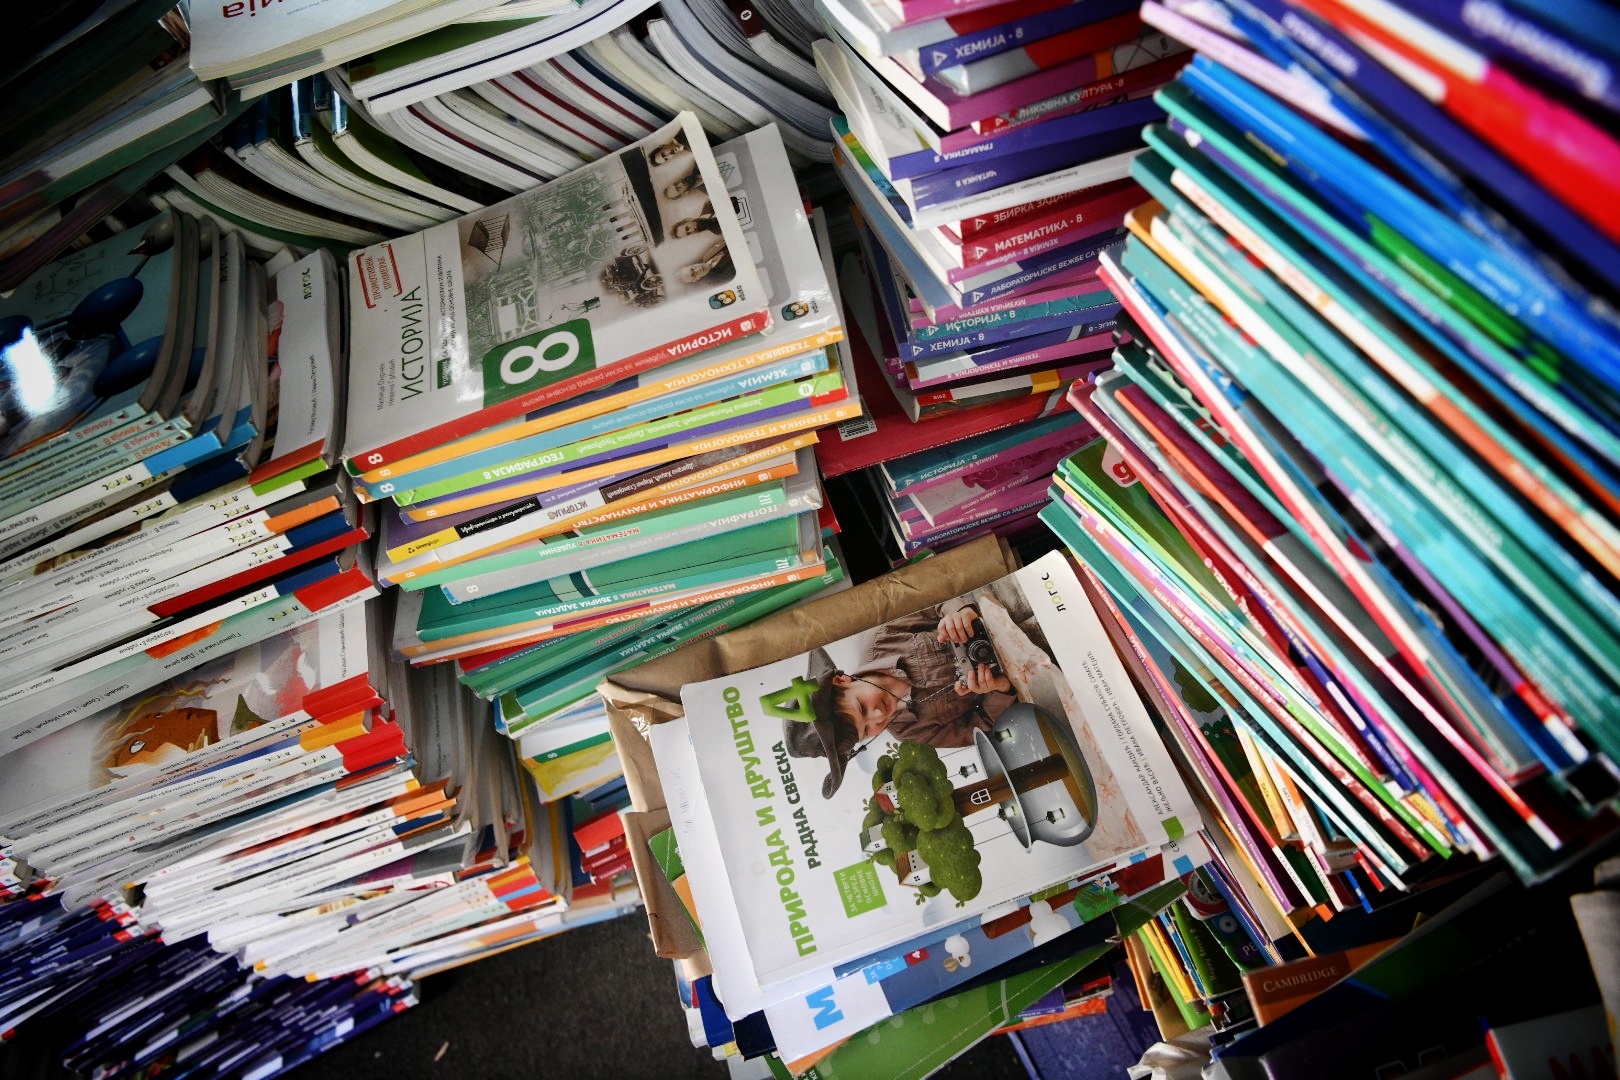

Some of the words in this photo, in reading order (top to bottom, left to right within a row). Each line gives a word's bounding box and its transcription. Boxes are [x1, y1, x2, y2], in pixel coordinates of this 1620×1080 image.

[954, 32, 1006, 57] ХЕМИЈА
[1014, 26, 1024, 38] 8
[1018, 94, 1068, 118] ЛИКОВНА
[1068, 82, 1113, 102] КУЛТУРА
[942, 141, 993, 160] ГРАМАТИКА
[961, 169, 997, 184] ЧИТАНКА
[992, 202, 1033, 223] ЗБИРКА
[994, 220, 1068, 252] МАТЕМАТИКА
[1074, 213, 1083, 223] 8
[1028, 237, 1059, 253] ХЕМИЈА
[366, 256, 380, 300] ПРОМОТИВНИ
[378, 254, 391, 289] ПРИМЕРАК
[989, 264, 1057, 294] ЛАБОРАТОРИЈСКЕ
[1057, 254, 1084, 269] ВЕЖБЕ
[1084, 250, 1095, 259] СА
[302, 267, 310, 299] логос
[990, 298, 1025, 311] МУЗИЧКА
[945, 313, 1001, 331] ИСТОРИЈА
[1008, 310, 1015, 318] 8
[401, 283, 421, 403] ИСТОРИЈА
[666, 326, 732, 357] ИСТОРИЈА
[756, 340, 809, 361] ТЕХНИКА
[929, 336, 970, 351] ХЕМИЈА
[500, 331, 580, 385] 8
[745, 356, 754, 365] И
[1008, 352, 1038, 363] ТЕХНИКА
[663, 360, 743, 389] ТЕХНОЛОГИЈА
[737, 367, 787, 388] ХЕМИЈА
[953, 361, 1001, 377] ТЕХНОЛОГИЈА
[83, 417, 114, 435] Хемија
[111, 423, 142, 442] Хемија
[767, 425, 776, 433] И
[778, 412, 829, 431] ТЕХНИКА
[130, 428, 162, 447] Хемија
[141, 438, 172, 457] Хемија
[691, 427, 766, 452] ТЕХНОЛОГИЈА
[368, 453, 383, 466] 8
[492, 450, 564, 477] ГЕОГРАФИЈА
[728, 459, 739, 468] И
[740, 443, 787, 463] ТЕХНИКА
[379, 467, 390, 476] 8
[482, 470, 492, 479] 8
[658, 463, 726, 491] ТЕХНОЛОГИЈА
[919, 458, 965, 480] ИСТОРИЈА
[378, 481, 394, 494] 8
[659, 478, 746, 506] ИНФОРМАТИКА
[426, 508, 436, 516] 8
[571, 503, 646, 529] РАЧУНАРСТВО
[648, 501, 657, 509] И
[708, 504, 777, 528] ГЕОГРАФИЈА
[584, 527, 639, 545] МАТЕМАТИКА
[538, 541, 576, 556] УЏБЕНИК
[466, 584, 478, 593] 8
[618, 582, 675, 599] МАТЕМАТИКА
[690, 577, 775, 605] ИНФОРМАТИКА
[1042, 572, 1066, 612] логос
[1082, 566, 1096, 584] Family
[1100, 592, 1116, 612] Friends
[1210, 567, 1239, 601] PIXEL
[534, 601, 577, 616] ЗАДАТАКА
[578, 595, 611, 608] ЗБИРКА
[679, 599, 688, 607] И
[688, 598, 735, 621] МАТЕМАТИКА
[1151, 588, 1184, 619] НЕМАЧКИ
[1182, 616, 1204, 637] ЈЕЗИК
[604, 601, 678, 625] РАЧУНАРСТВО
[656, 622, 682, 639] ЗБИРКА
[618, 634, 656, 656] ЗАДАТАКА
[1100, 678, 1113, 696] ИВАН
[756, 670, 829, 734] 4
[1106, 710, 1126, 740] ГОРДАНА
[1111, 700, 1134, 734] ПЕТРОВИЋ
[718, 683, 773, 802] ДРУШТВО
[769, 739, 802, 805] СВЕСКА
[1137, 771, 1165, 816] АЛЕКСАНДАР
[755, 804, 777, 826] И
[791, 805, 824, 869] РАДНА
[763, 827, 818, 957] ПРИРОДА
[838, 870, 855, 903] ЧЕТВРТИ
[848, 873, 864, 903] РАЗРЕД
[855, 867, 873, 904] ОСНОВНЕ
[864, 869, 880, 897] ШКОЛЕ
[1262, 962, 1338, 994] CAMBRIDGE
